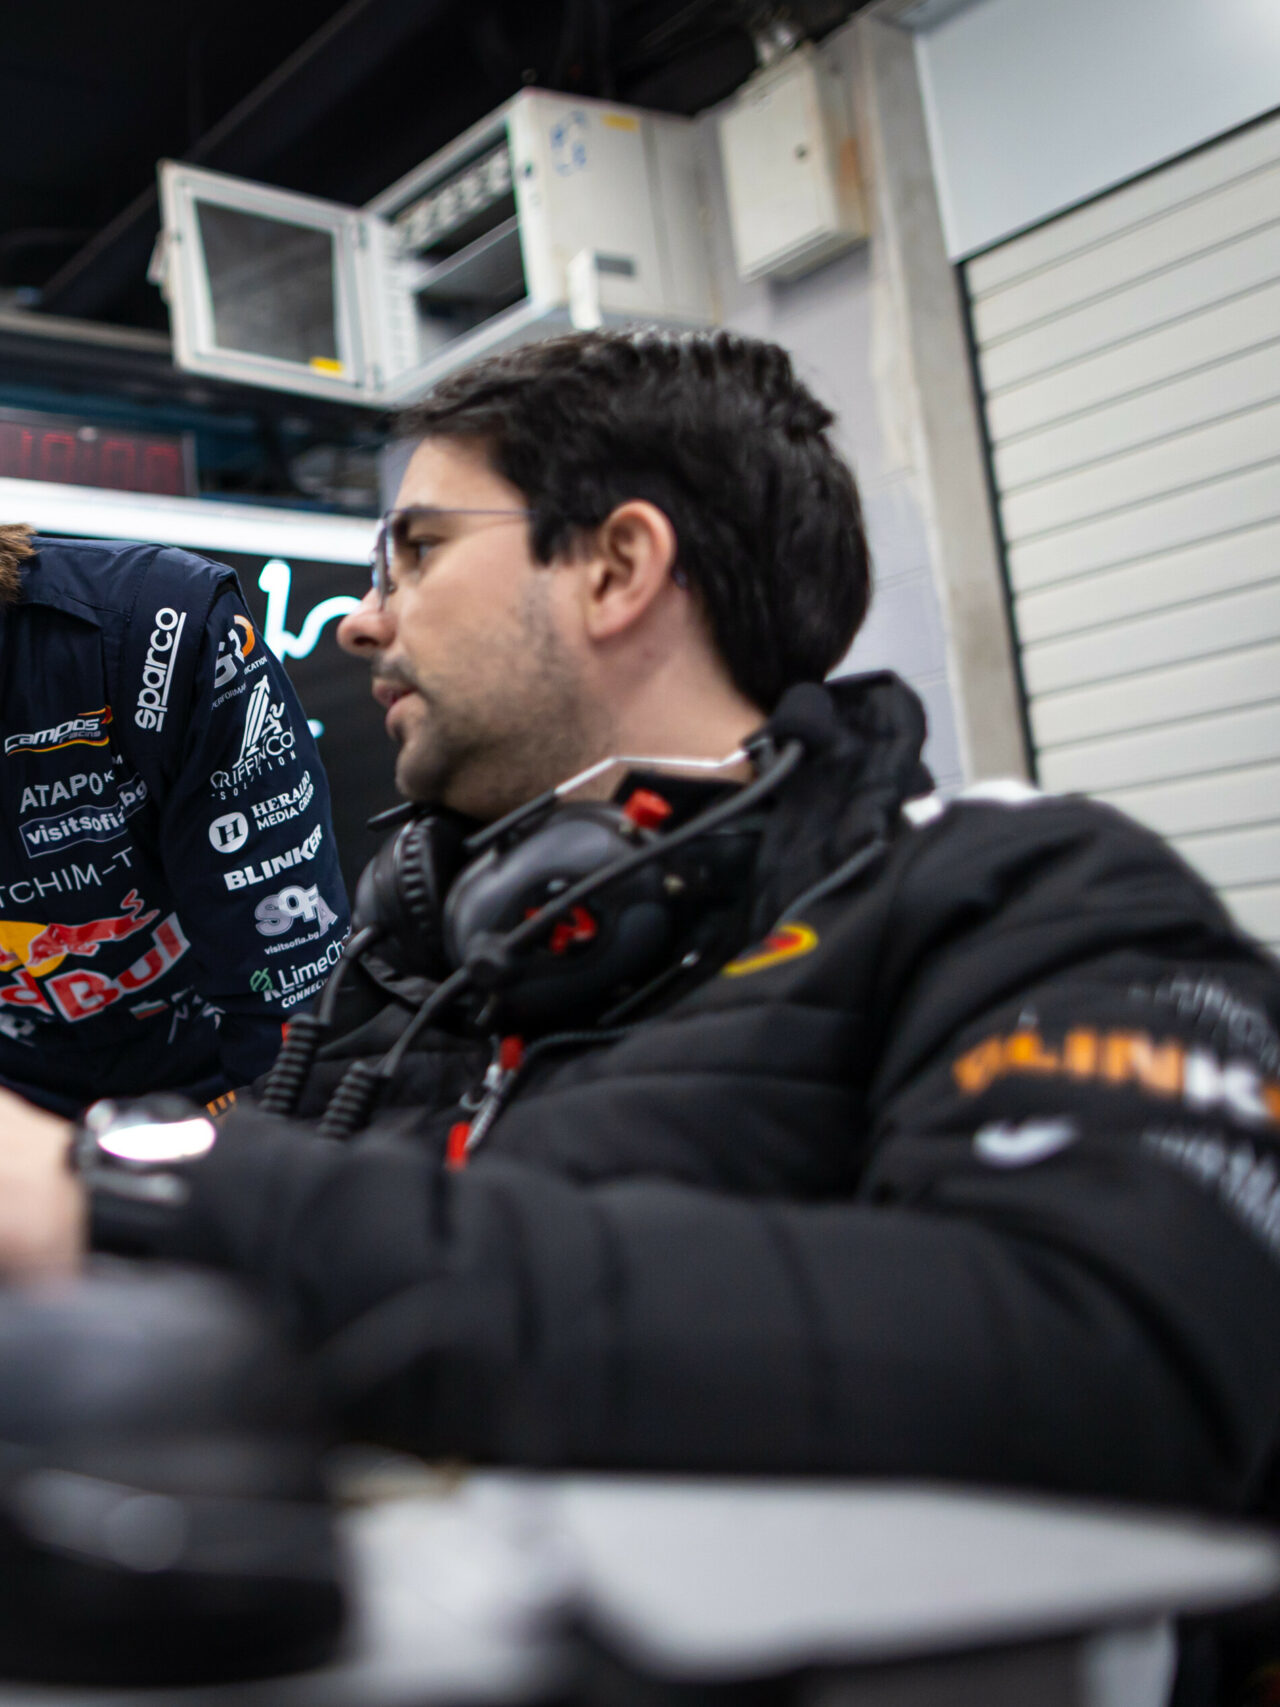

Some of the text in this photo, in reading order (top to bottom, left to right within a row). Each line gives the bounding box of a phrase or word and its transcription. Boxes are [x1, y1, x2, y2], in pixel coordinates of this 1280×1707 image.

[135, 607, 182, 731] sparco
[256, 806, 300, 831] MEDIA
[223, 823, 322, 891] BLINKER
[264, 931, 320, 955] visitsofia.bg
